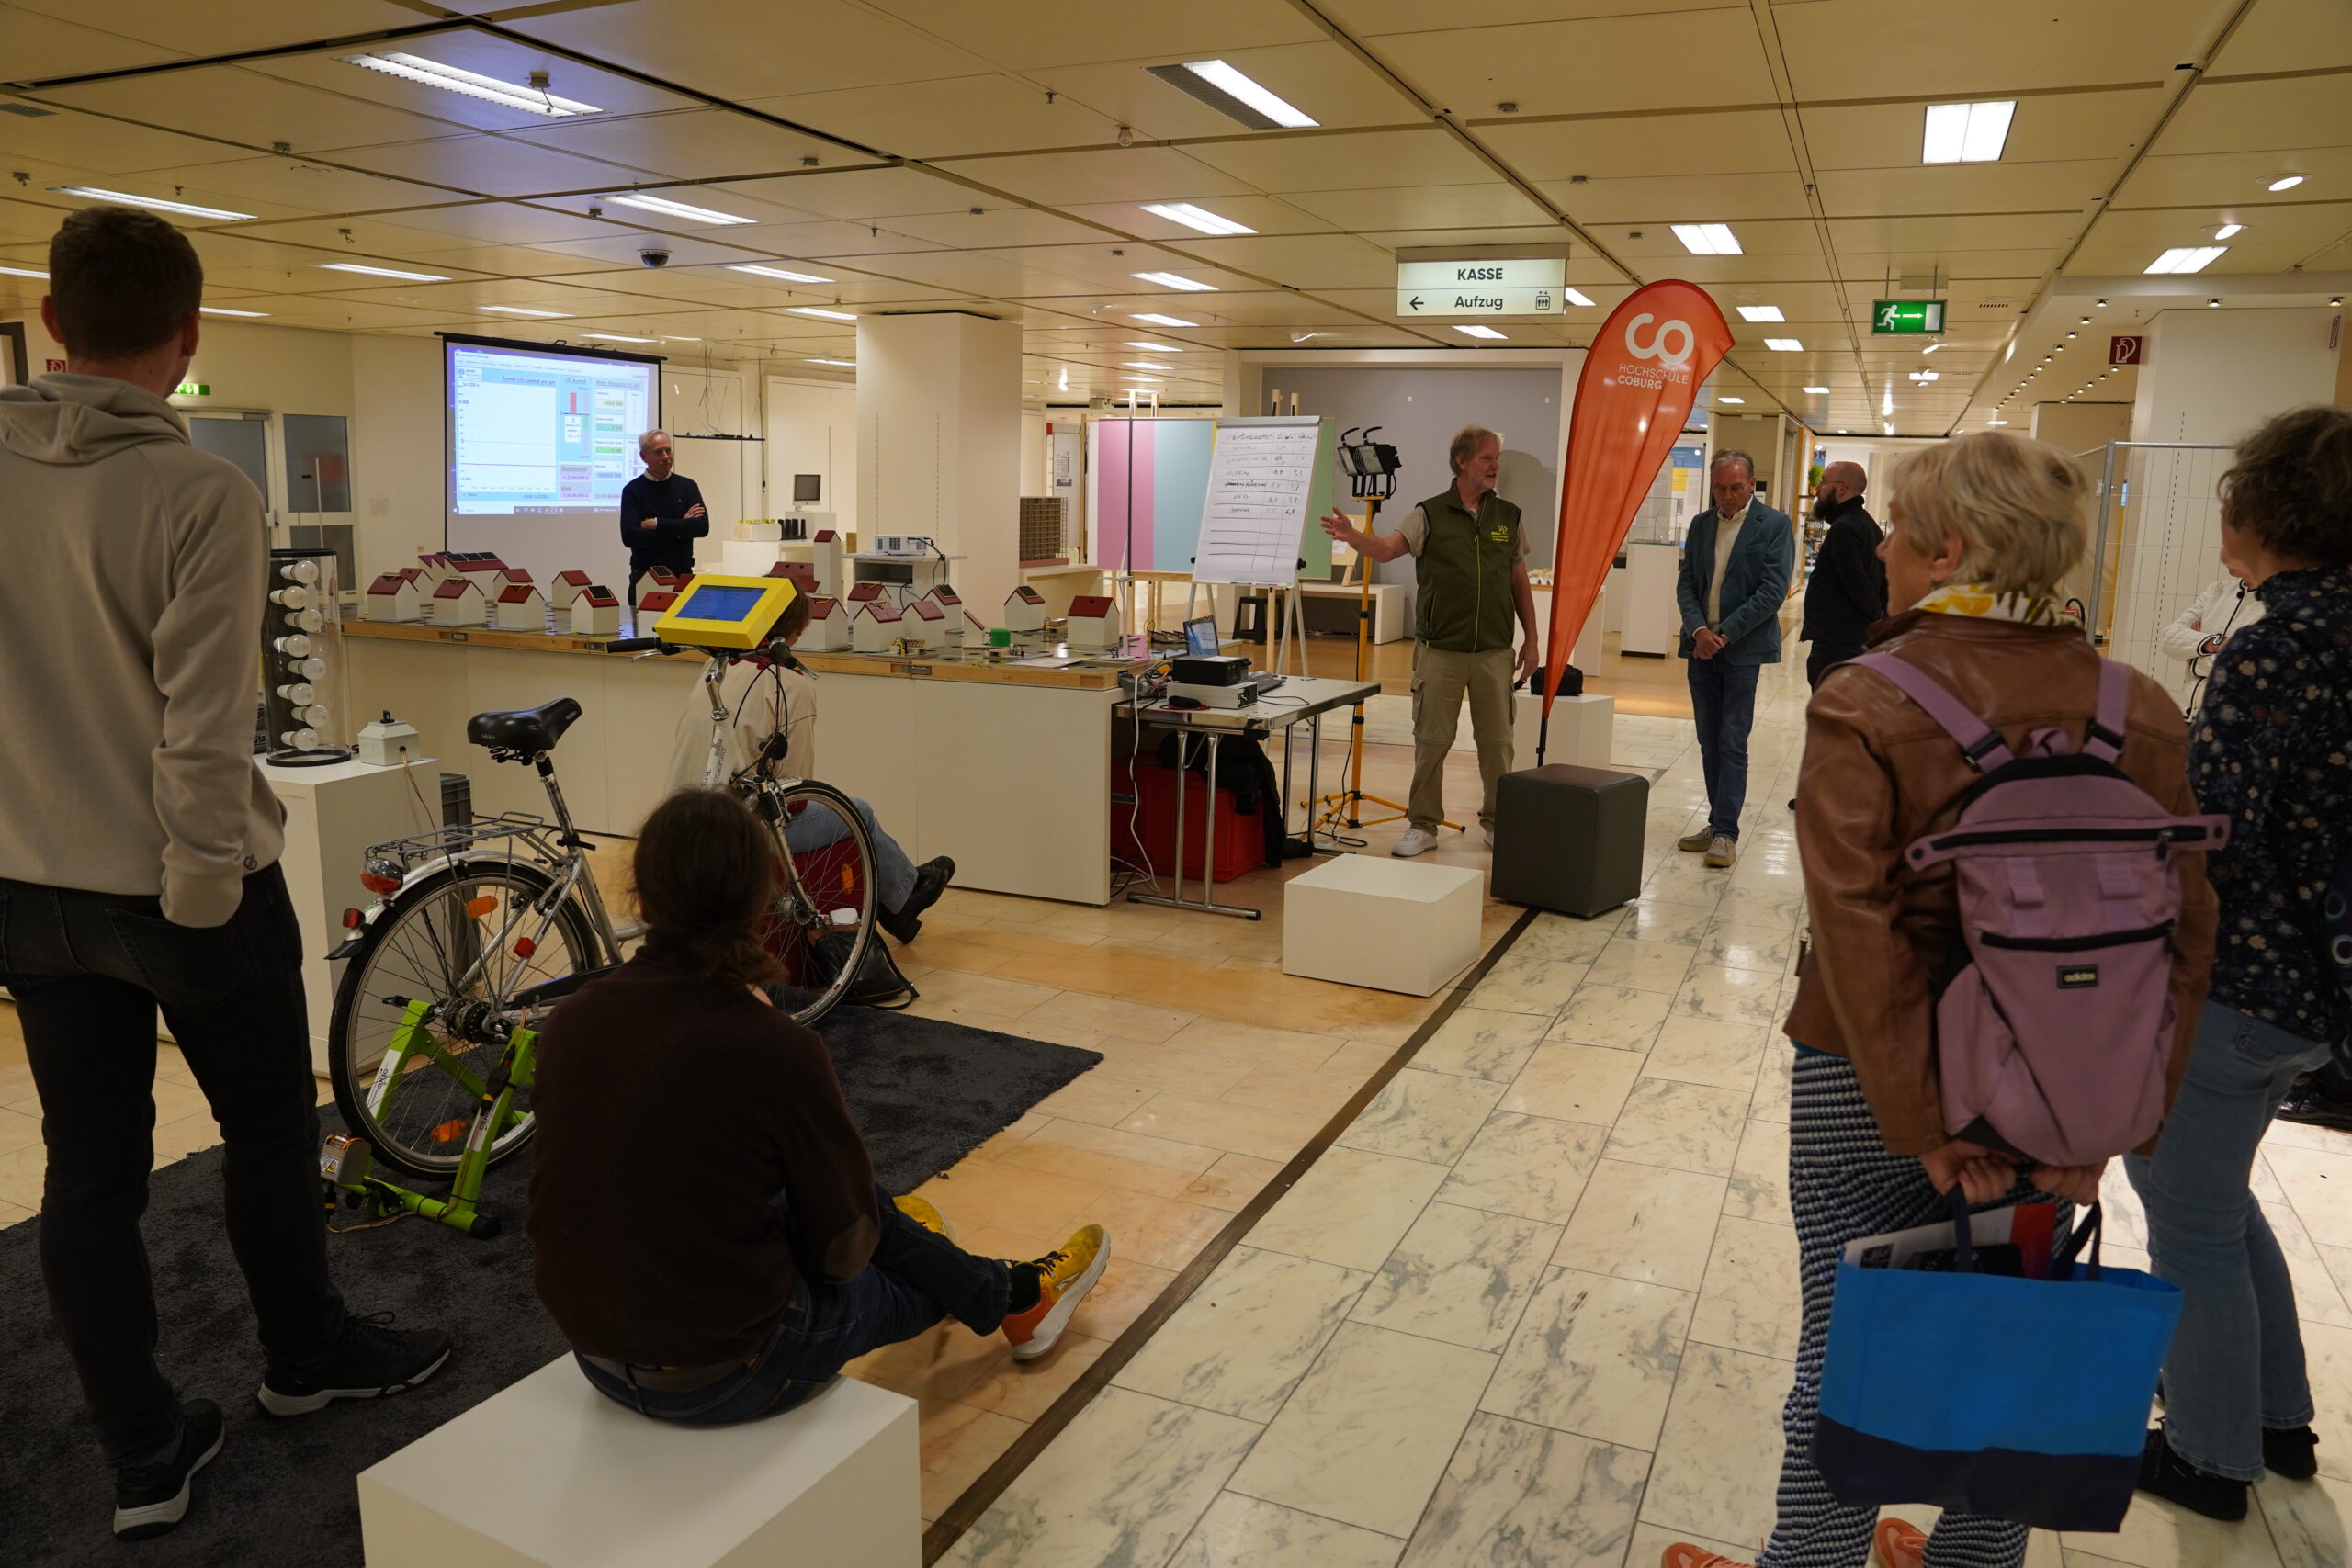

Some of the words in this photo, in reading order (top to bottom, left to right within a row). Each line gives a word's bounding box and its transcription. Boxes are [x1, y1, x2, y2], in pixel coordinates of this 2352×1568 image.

[1457, 267, 1503, 280] KASSE
[1454, 296, 1504, 310] Aufzug
[1625, 312, 1694, 365] CO
[1619, 363, 1690, 384] HOCHSCHULE
[1617, 375, 1663, 390] COBURG
